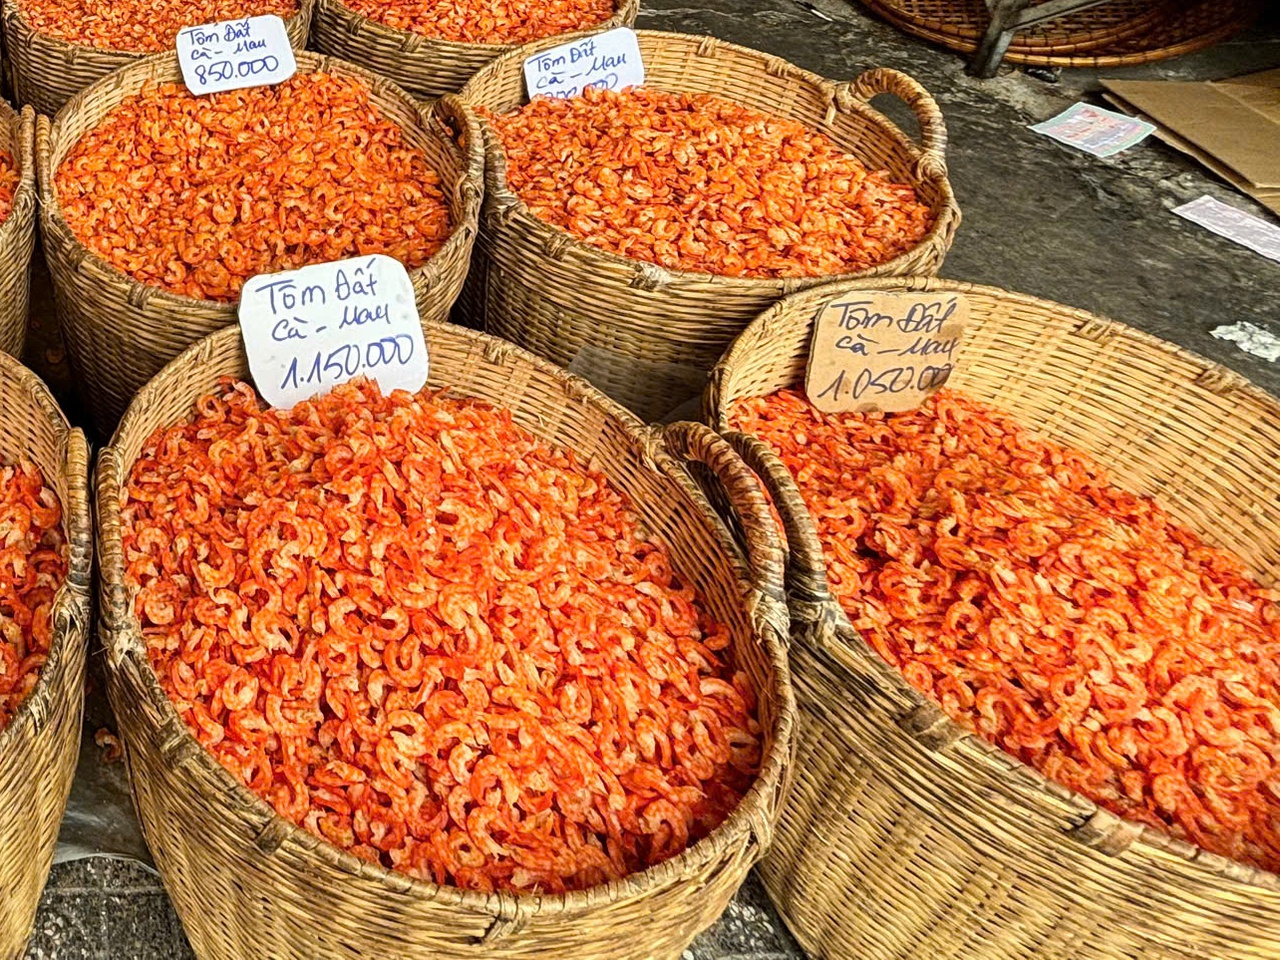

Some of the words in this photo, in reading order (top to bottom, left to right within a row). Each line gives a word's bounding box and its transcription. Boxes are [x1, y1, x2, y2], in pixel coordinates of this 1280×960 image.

[180, 26, 220, 45] Tôm
[223, 18, 251, 42] Đất
[195, 55, 279, 85] 850.000
[527, 52, 566, 72] Tôm
[570, 38, 596, 63] Đất
[254, 279, 326, 315] Tôm
[335, 257, 378, 301] Đất
[830, 300, 894, 331] Tôm
[897, 296, 958, 334] Đất
[280, 333, 414, 390] 1.150.000
